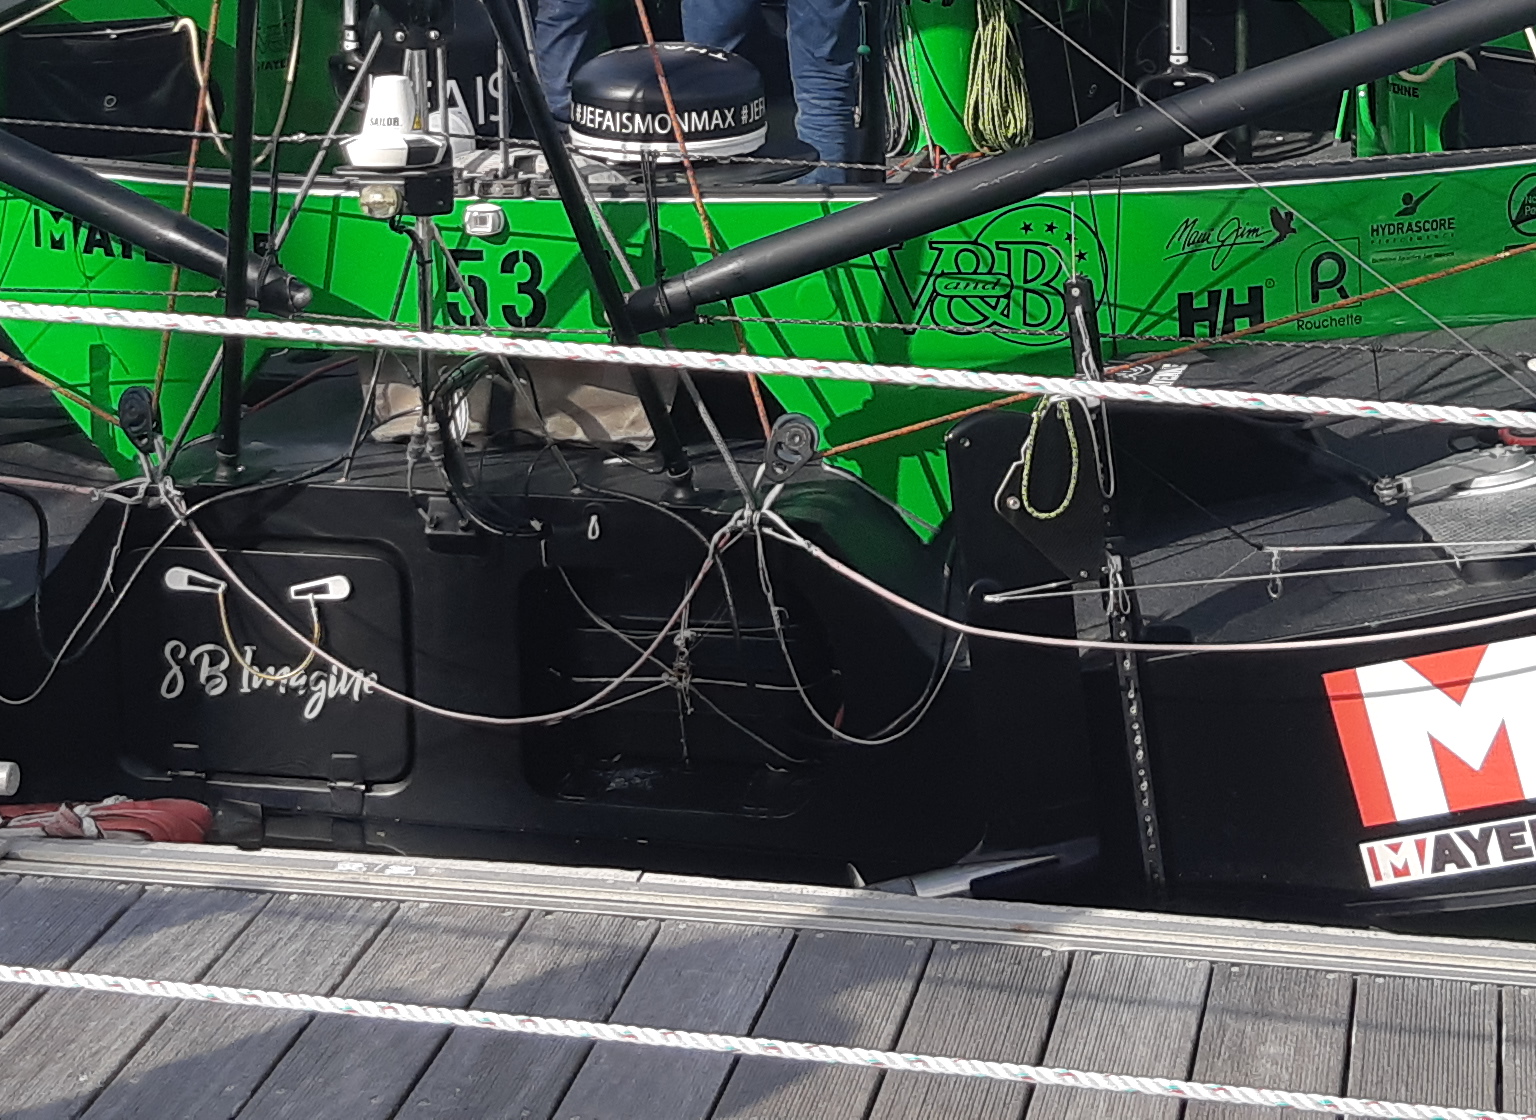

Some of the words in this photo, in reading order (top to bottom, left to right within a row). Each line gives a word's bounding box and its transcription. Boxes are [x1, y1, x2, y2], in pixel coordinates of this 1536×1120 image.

[575, 101, 736, 135] #JEFAISMONMAX
[1370, 217, 1457, 237] HYDRASCORE
[445, 248, 547, 328] 53
[943, 271, 1001, 292] and
[1296, 313, 1363, 332] Rouchette
